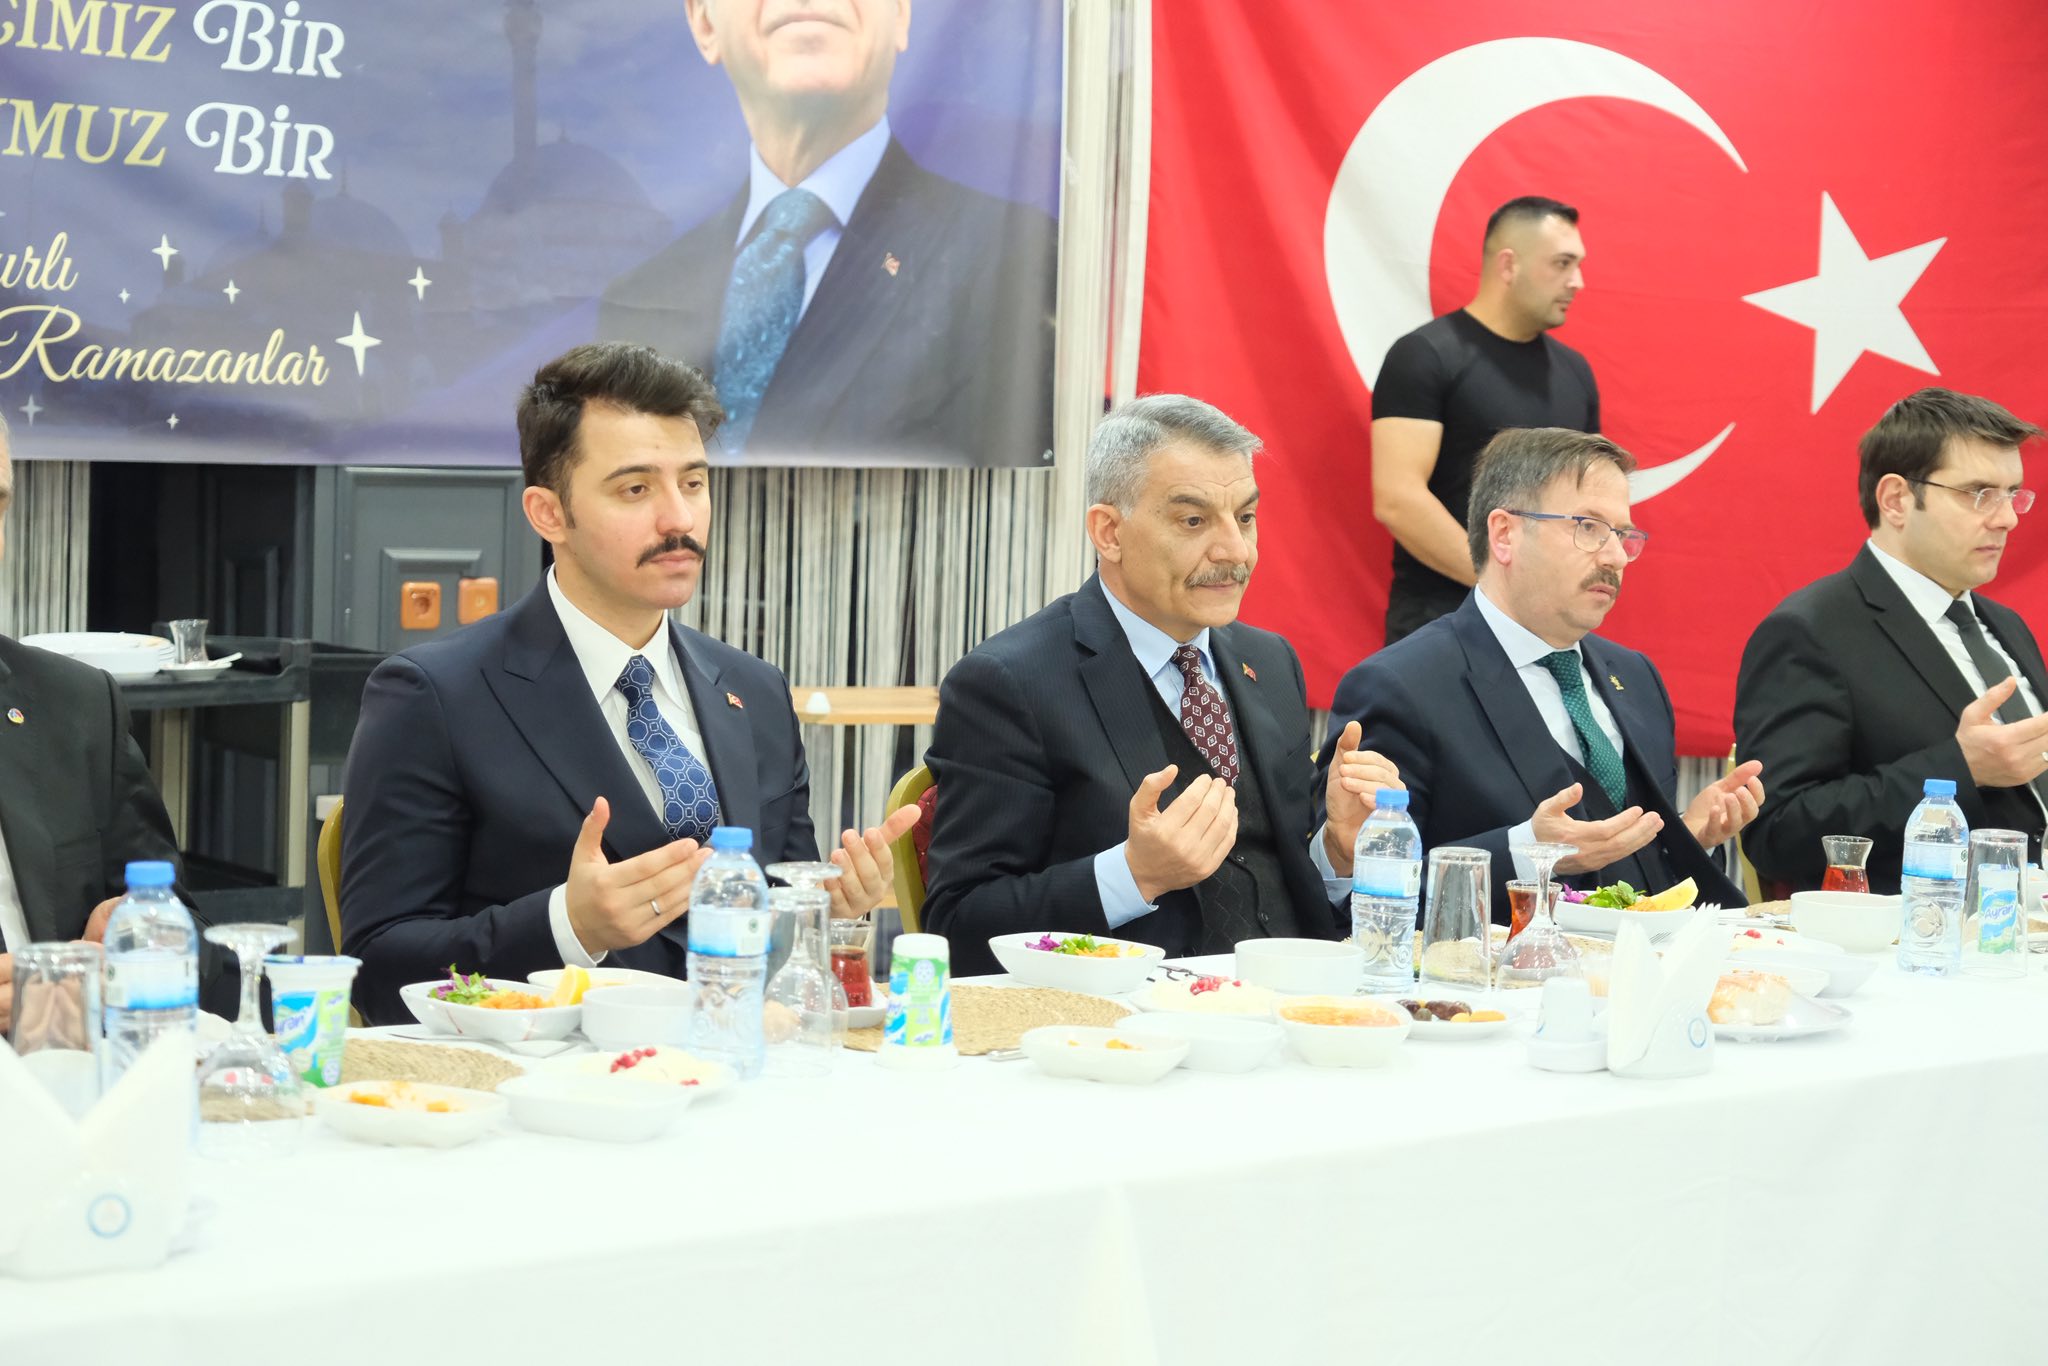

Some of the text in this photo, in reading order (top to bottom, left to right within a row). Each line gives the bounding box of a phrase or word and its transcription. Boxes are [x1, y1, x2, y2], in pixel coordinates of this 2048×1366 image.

[193, 0, 345, 78] BİR
[0, 98, 334, 180] MUZ BİR
[0, 304, 329, 386] Ramazanlar
